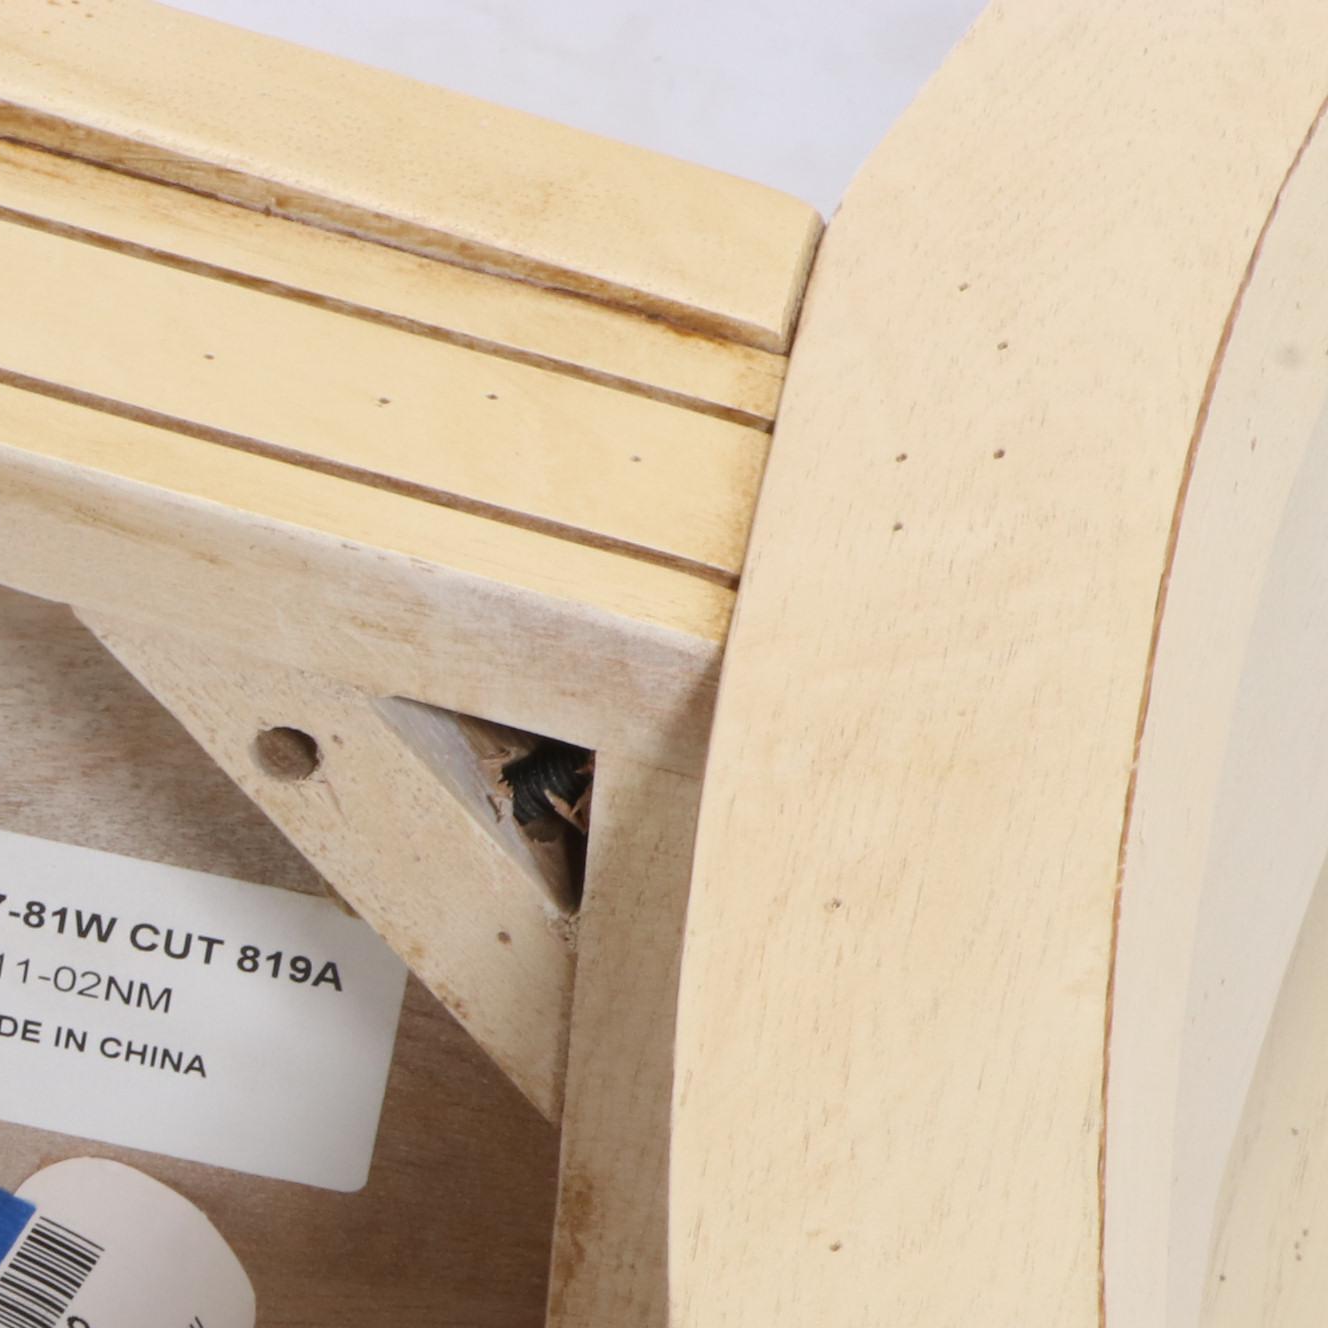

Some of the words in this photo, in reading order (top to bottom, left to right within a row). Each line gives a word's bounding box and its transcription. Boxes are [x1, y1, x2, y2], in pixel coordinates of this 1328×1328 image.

[129, 923, 225, 965] CUT
[236, 945, 343, 992] 819A
[54, 1026, 87, 1052] IN
[99, 1037, 206, 1078] CHINA
